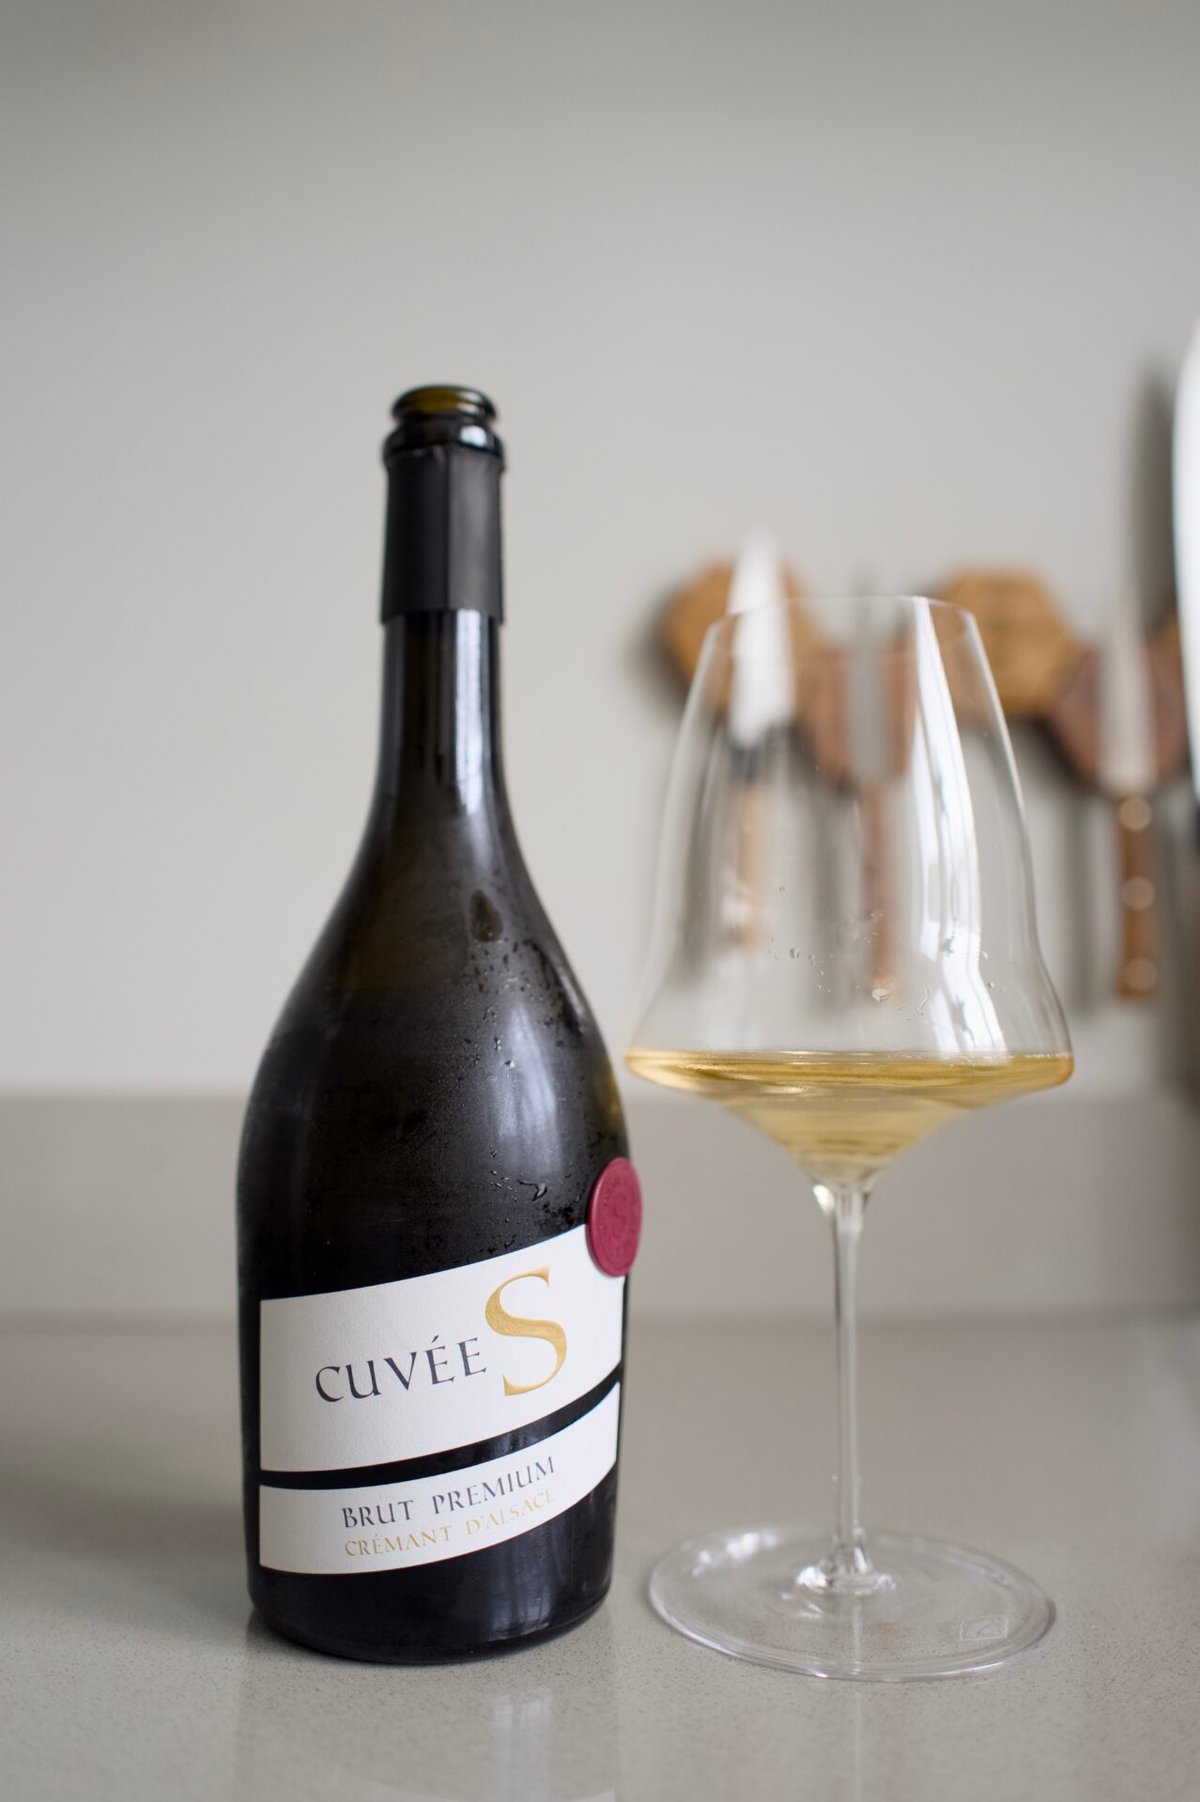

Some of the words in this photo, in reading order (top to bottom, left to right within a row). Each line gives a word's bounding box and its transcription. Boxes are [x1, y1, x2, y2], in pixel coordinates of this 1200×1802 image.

[316, 1335, 487, 1402] CUVÉE
[485, 1267, 567, 1396] S
[342, 1500, 414, 1529] BRUT
[431, 1456, 555, 1515] PREMIUM
[344, 1525, 452, 1557] CRÉMANT
[465, 1488, 555, 1536] D'ALSACE
